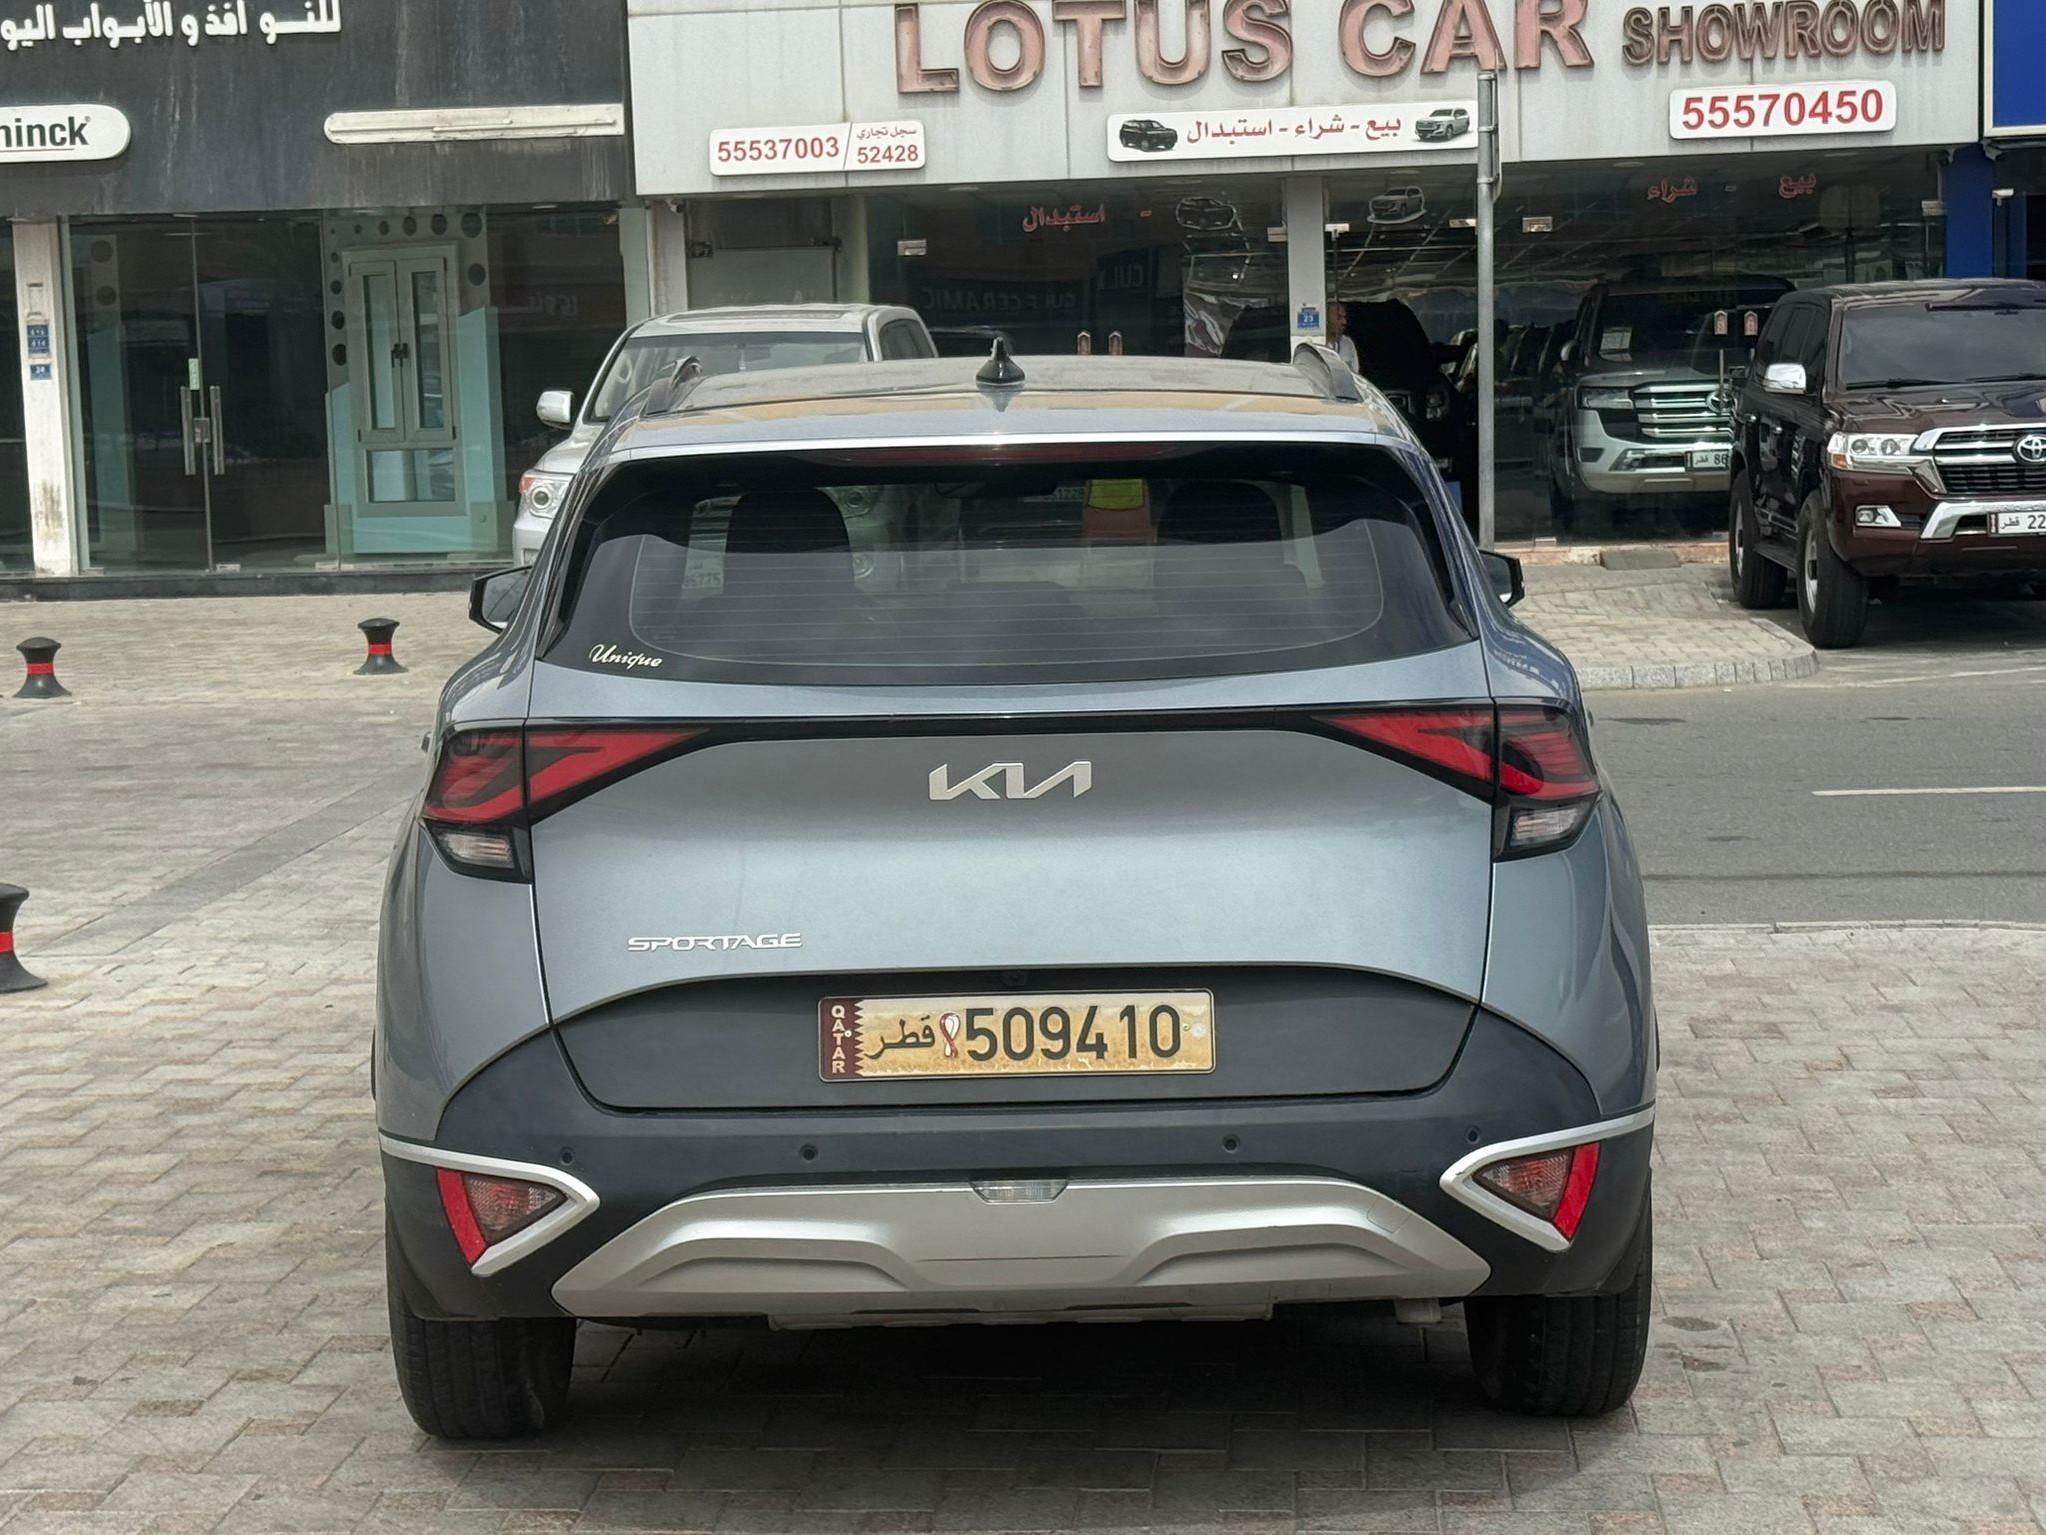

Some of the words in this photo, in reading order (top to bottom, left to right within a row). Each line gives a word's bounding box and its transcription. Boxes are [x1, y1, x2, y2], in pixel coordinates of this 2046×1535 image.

[895, 0, 1293, 93] LOTUS
[1338, 0, 1595, 77] CAR
[1621, 0, 1946, 66] SHOWROOM
[1682, 88, 1884, 131] 55570450
[857, 127, 889, 140] تجاري
[890, 126, 917, 138] سجل
[1187, 118, 1273, 145] استبدال
[1294, 113, 1345, 140] شراء
[1365, 117, 1401, 141] بيع
[717, 136, 840, 162] 55537003
[857, 144, 919, 164] 52428
[1647, 175, 1698, 203] شراء
[1777, 172, 1817, 199] بيع
[1022, 203, 1106, 232] استبدال
[1999, 516, 2020, 529] قطر
[2027, 514, 2046, 530] 22
[588, 643, 663, 670] Unique
[929, 761, 1092, 800] KIA
[628, 932, 803, 952] SPORTAGE
[831, 1004, 846, 1074] QATAR
[864, 1014, 936, 1060] قطر
[965, 1004, 1182, 1062] 509410
